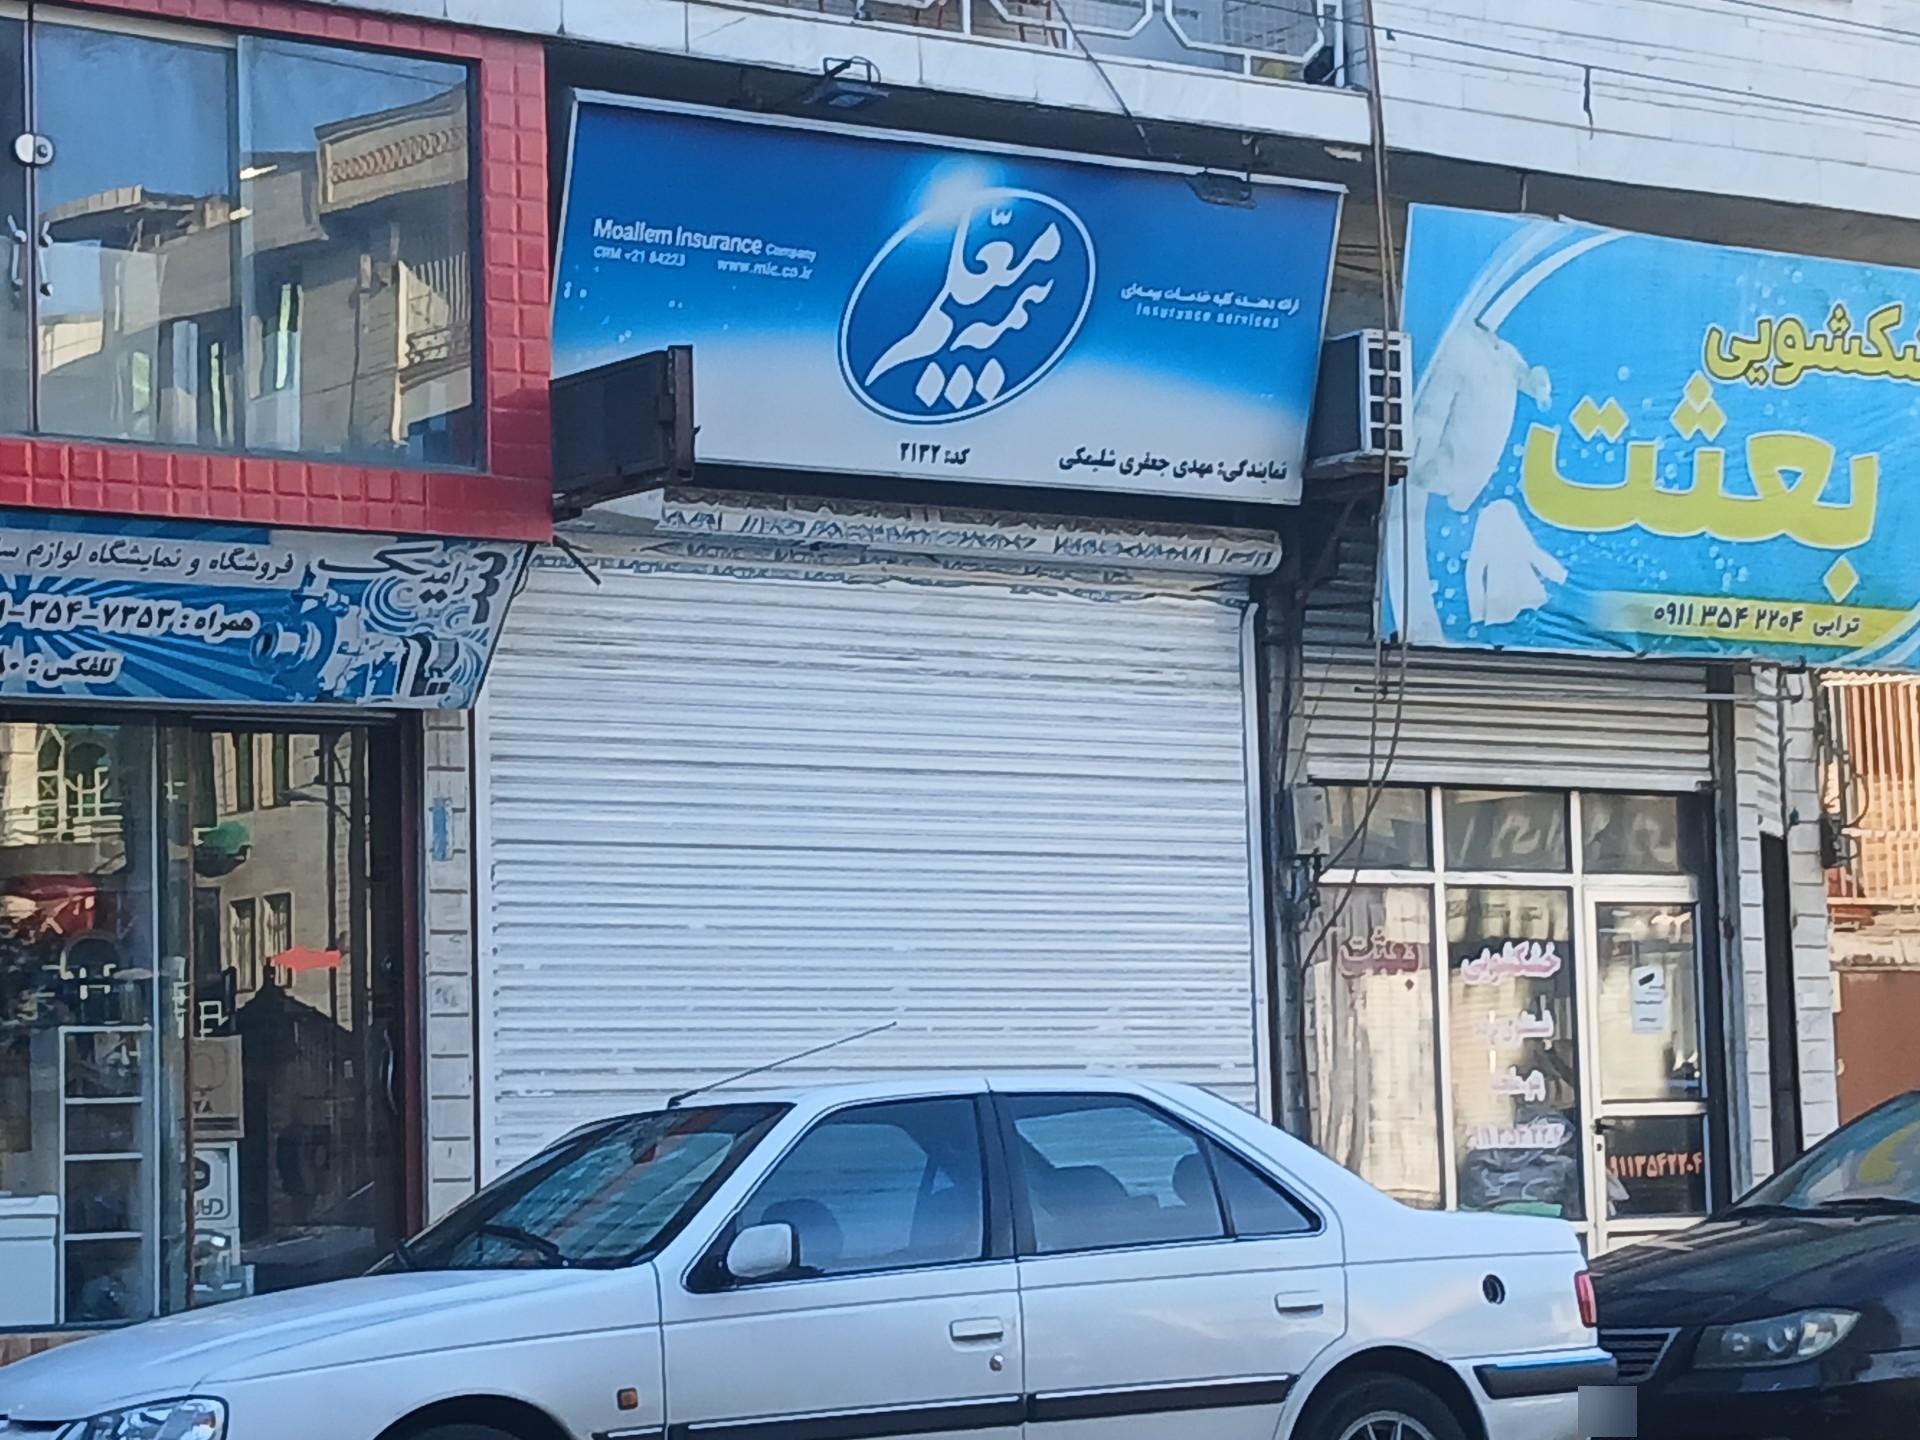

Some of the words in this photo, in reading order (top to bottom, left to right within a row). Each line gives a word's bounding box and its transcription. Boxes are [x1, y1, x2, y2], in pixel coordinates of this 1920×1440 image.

[593, 217, 673, 246] Moallem
[675, 225, 763, 255] Insurance
[764, 243, 817, 263] Company
[1119, 451, 1170, 477] جعفری
[1173, 459, 1214, 479] مهدی
[1217, 459, 1287, 484] نمایندگی:
[1522, 370, 1879, 603] بعثت
[26, 540, 83, 568] لوازم
[88, 538, 182, 573] نمایشگاه
[185, 555, 201, 576] و
[208, 547, 294, 581] فروشگاه
[1653, 601, 1694, 626] ۰۹۱۱
[1699, 604, 1749, 629] ۳۵۴
[1812, 614, 1861, 638] ترابی
